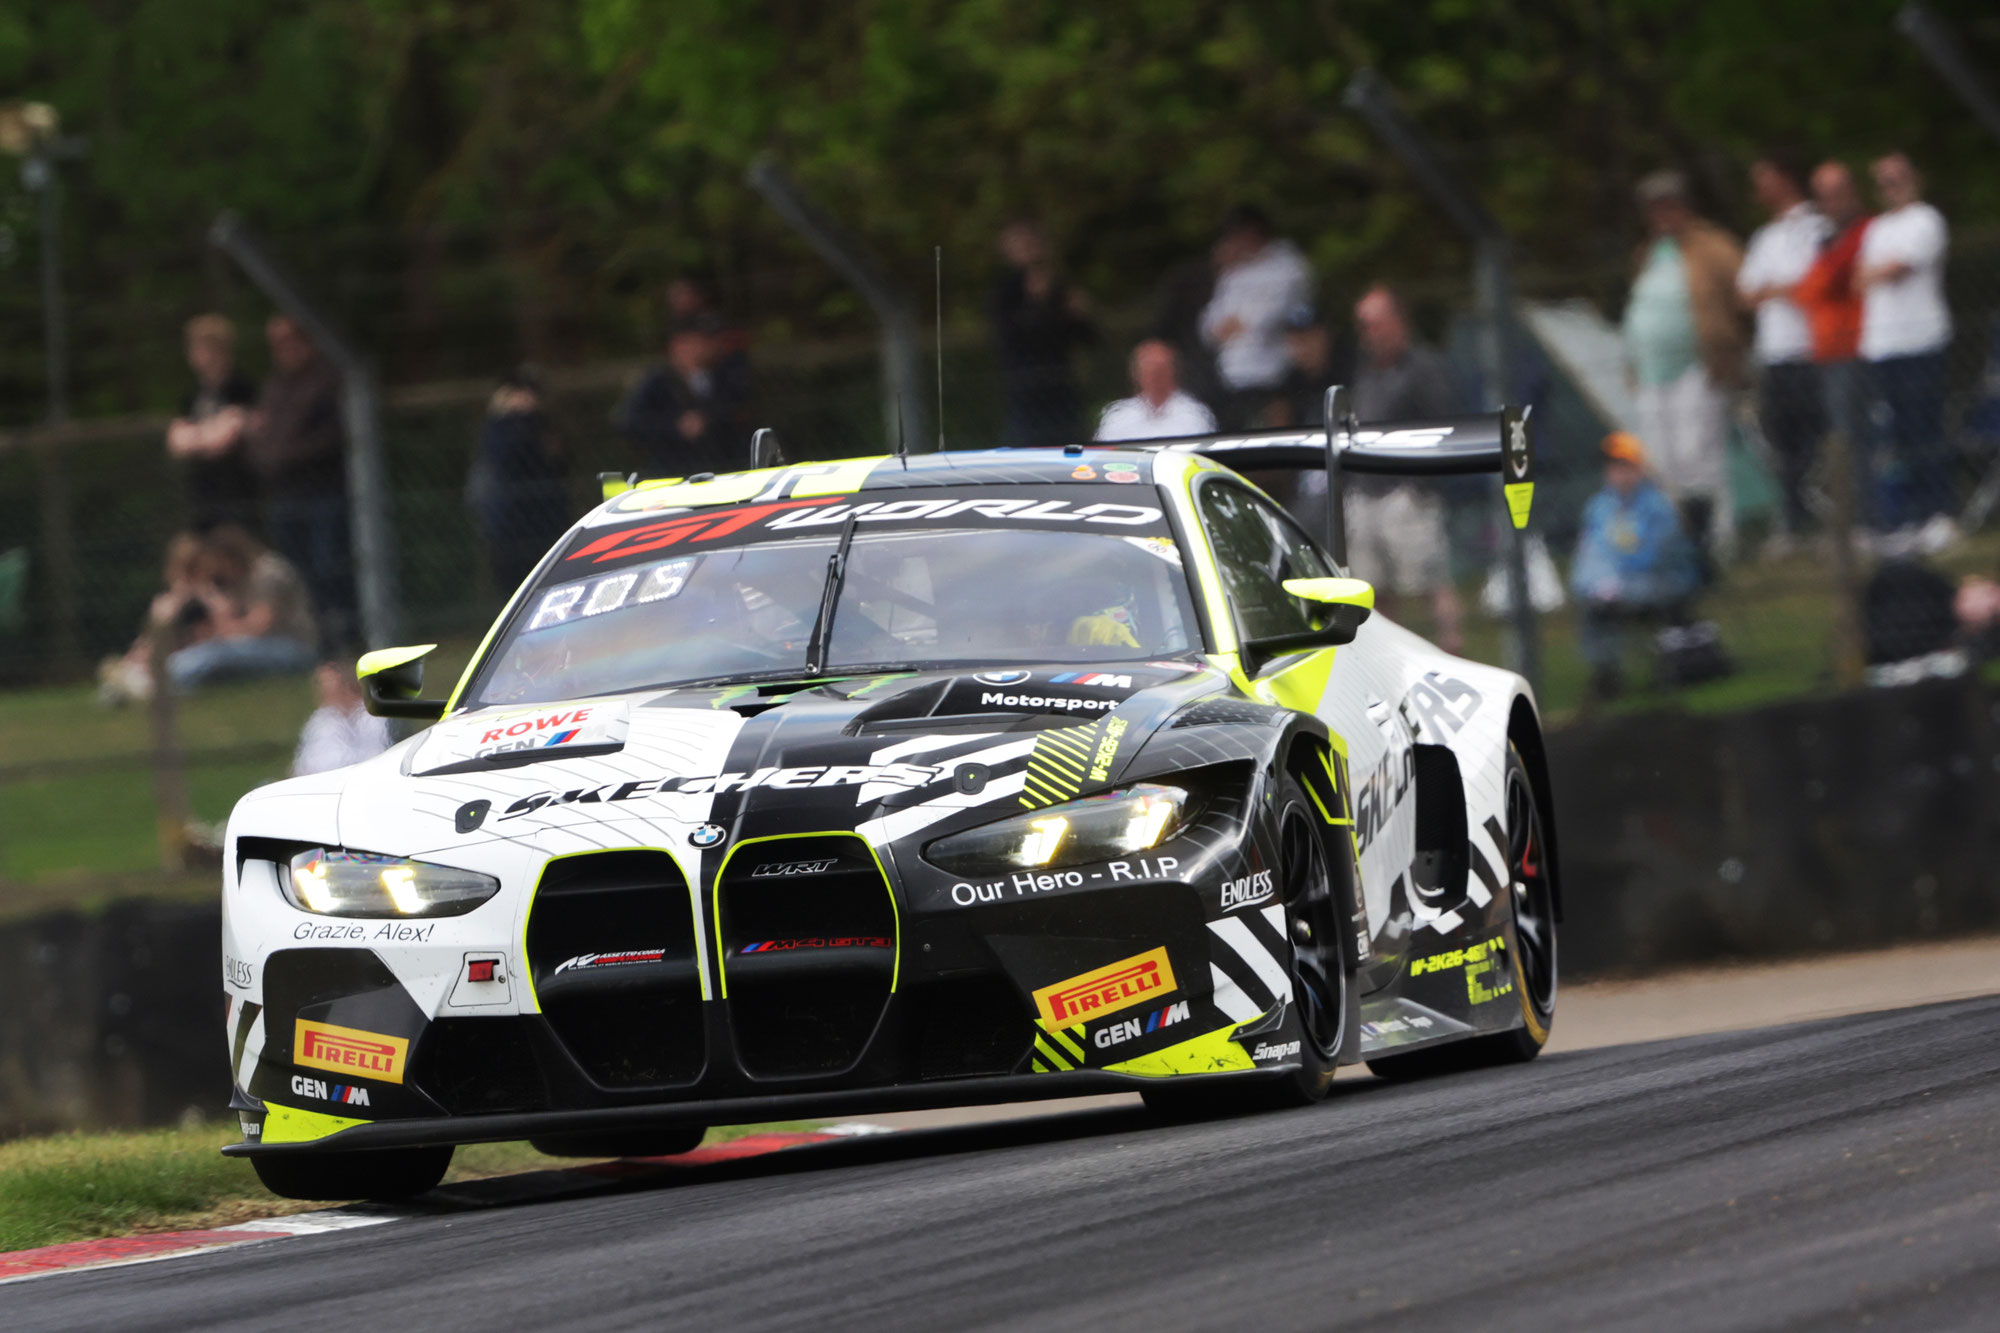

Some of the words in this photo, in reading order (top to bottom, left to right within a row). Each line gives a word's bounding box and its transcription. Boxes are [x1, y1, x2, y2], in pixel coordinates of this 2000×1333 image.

[565, 496, 845, 564] GT
[765, 499, 1163, 530] WORLD
[530, 562, 688, 630] ROS
[981, 692, 1119, 711] Motorsport
[480, 708, 593, 744] ROWE
[498, 762, 944, 822] SKECHERS
[752, 858, 839, 877] WRT
[951, 881, 1005, 906] Our
[1012, 871, 1083, 895] Hero
[1108, 857, 1185, 881] R.I.P.
[1221, 868, 1273, 907] ENDLESS
[293, 922, 367, 942] Grazie,
[374, 923, 435, 942] Alex!
[1048, 959, 1158, 1022] PIRELLI
[303, 1029, 396, 1073] PIRELLI
[1094, 1017, 1142, 1049] GEN
[1253, 1040, 1301, 1061] Snap-on
[291, 1074, 329, 1101] GEN
